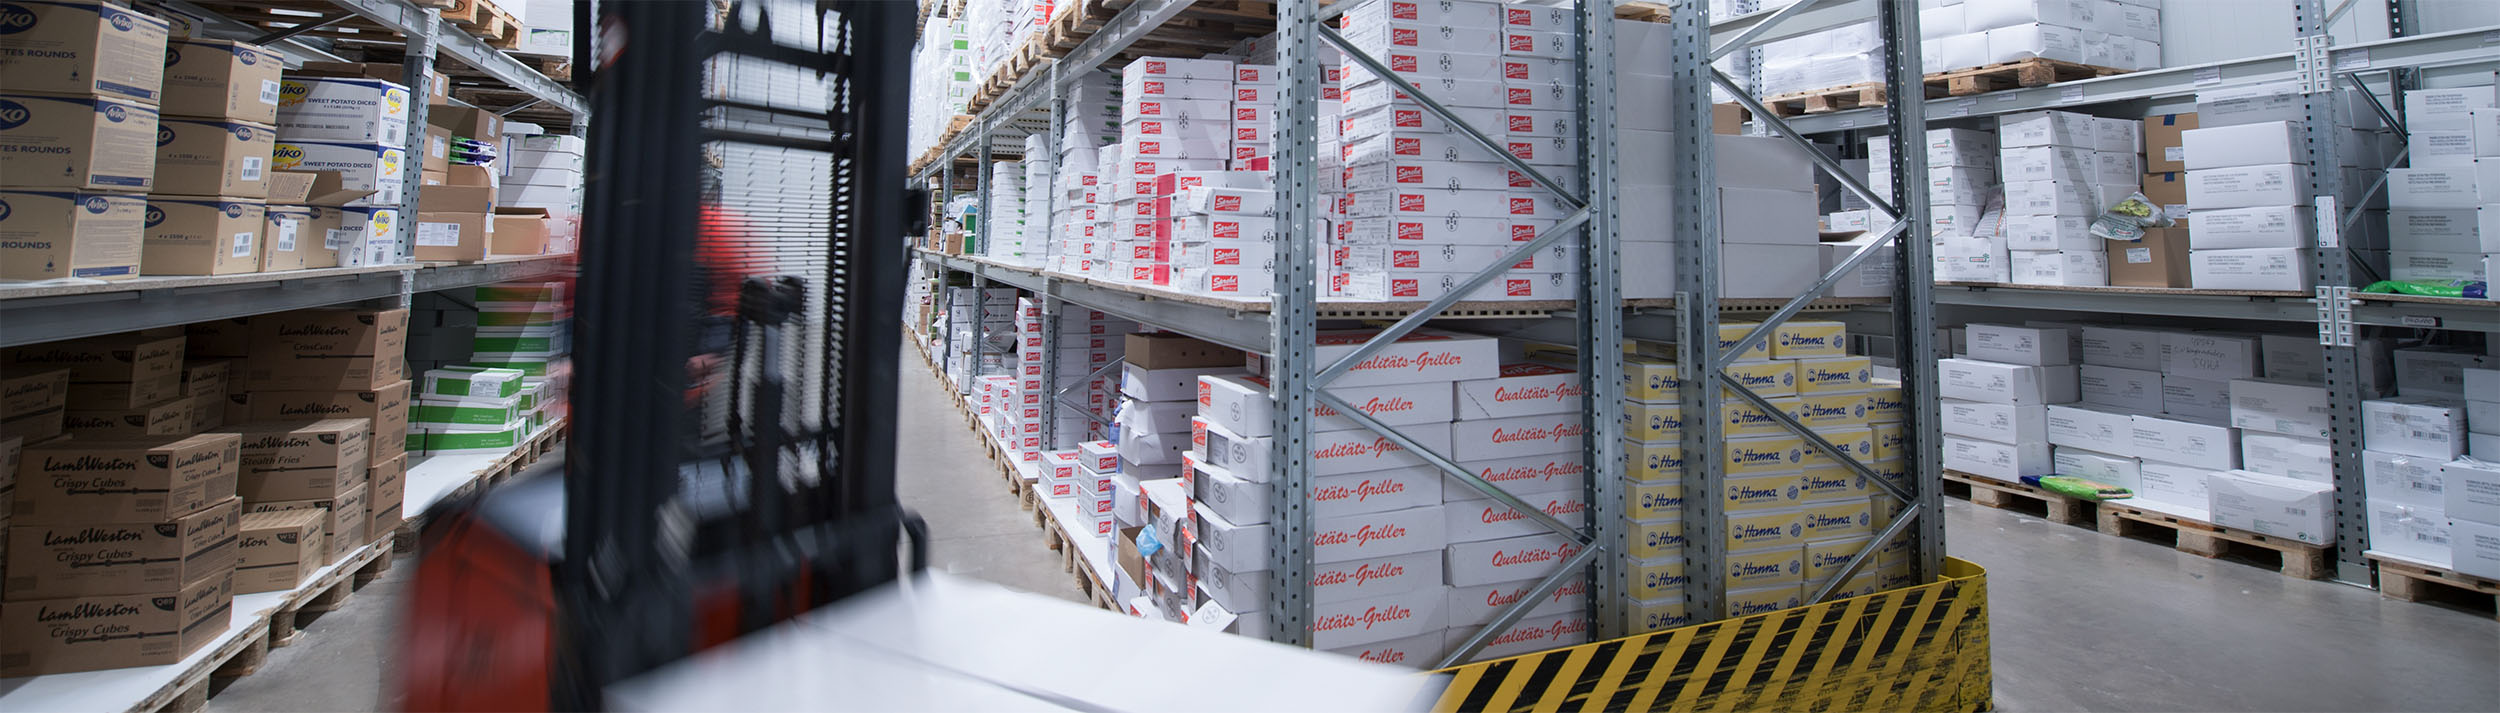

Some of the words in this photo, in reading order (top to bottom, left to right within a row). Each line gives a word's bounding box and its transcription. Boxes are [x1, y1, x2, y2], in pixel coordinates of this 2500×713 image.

[27, 50, 76, 59] ROUNDS
[20, 146, 71, 154] ROUNDS
[272, 146, 301, 158] viko
[2, 241, 52, 249] ROUNDS
[1790, 333, 1825, 346] Hanna
[1350, 352, 1462, 372] ualitäts-Griller
[1742, 372, 1775, 385] Hanna
[1816, 369, 1850, 381] Hanna
[280, 402, 350, 416] LambWeston
[1812, 403, 1847, 416] Hanna
[240, 434, 311, 450] ambWeston
[176, 452, 220, 470] LambWeston
[1743, 448, 1779, 462] Hanna
[44, 455, 138, 472] LambWeston
[54, 478, 90, 488] Crispy
[92, 478, 126, 488] Cubes
[1810, 476, 1847, 490] Hanna
[1740, 486, 1778, 499] Hanna
[1816, 514, 1852, 528] Hanna
[43, 527, 143, 546] LambWeston
[1313, 524, 1406, 548] itäts-Griller
[1744, 524, 1782, 538] Hanna
[56, 551, 96, 562] Crispy
[97, 550, 134, 560] Cubes
[1313, 562, 1404, 588] itäts-Griller
[1742, 562, 1780, 576] Hanna
[38, 601, 140, 622] LambWeston
[1742, 600, 1778, 614] Hanna
[50, 626, 90, 639] Crispy
[93, 624, 130, 635] Cubes
